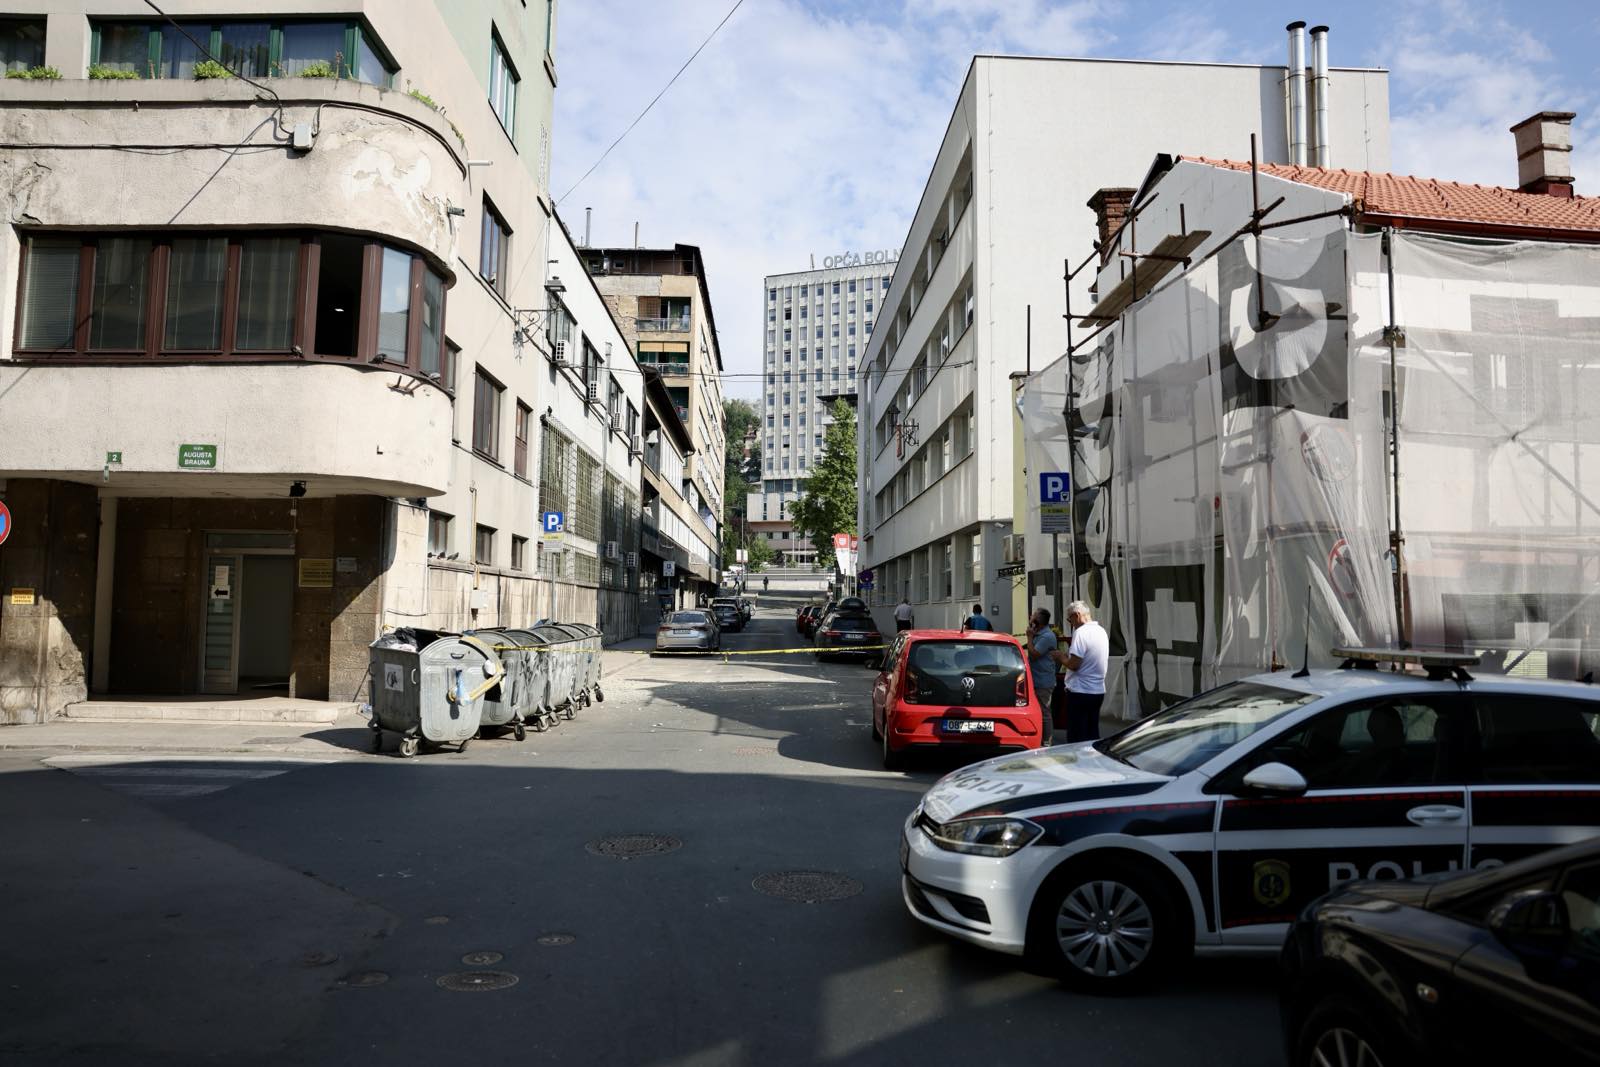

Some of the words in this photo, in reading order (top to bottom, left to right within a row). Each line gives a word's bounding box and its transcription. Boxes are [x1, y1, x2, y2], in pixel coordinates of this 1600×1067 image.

[823, 251, 862, 268] OPĆA
[1047, 477, 1063, 498] P
[548, 514, 559, 530] P
